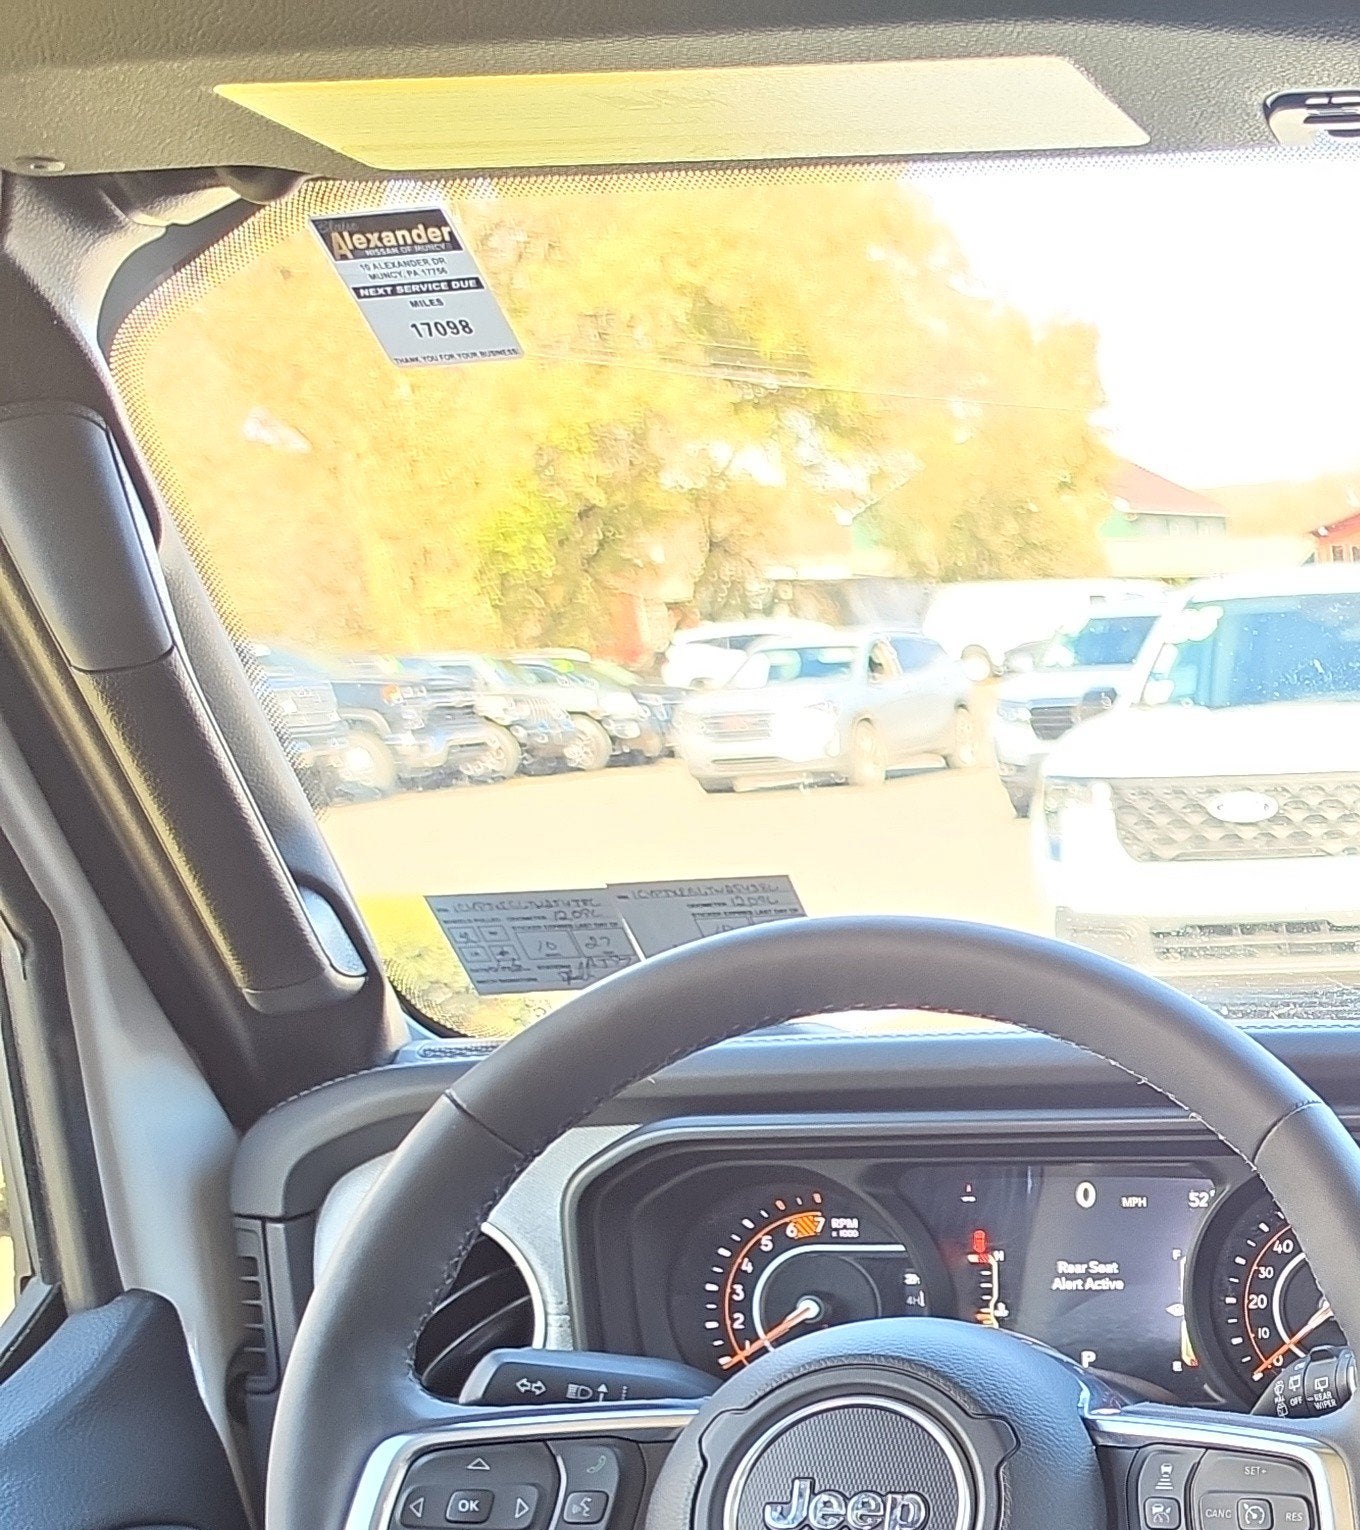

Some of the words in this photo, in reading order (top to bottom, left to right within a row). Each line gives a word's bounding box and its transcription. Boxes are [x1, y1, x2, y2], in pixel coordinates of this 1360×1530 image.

[330, 222, 452, 261] Alexander
[365, 247, 399, 257] NISSAN
[401, 246, 412, 254] OF
[414, 243, 446, 253] MUNCY
[373, 258, 429, 271] ALEXANDER
[432, 256, 447, 267] DR
[406, 269, 420, 278] PA
[360, 286, 394, 297] NEXT
[396, 282, 450, 294] SERVICE
[451, 279, 477, 290] DUE
[409, 298, 444, 309] MILES
[410, 318, 474, 339] 17098
[422, 355, 437, 363] YOU
[438, 353, 456, 362] FOR
[1075, 1181, 1096, 1208] 0
[1121, 1196, 1147, 1208] MPH
[815, 1216, 826, 1233] 7
[831, 1217, 859, 1229] RPM
[786, 1223, 798, 1238] 6
[760, 1235, 774, 1252] 5
[1272, 1239, 1294, 1254] 40
[741, 1258, 753, 1273] 4
[1056, 1260, 1087, 1274] Rear
[1088, 1260, 1119, 1274] Seat
[1258, 1266, 1274, 1279] 30
[1052, 1278, 1084, 1290] Alert
[1085, 1278, 1124, 1290] Active
[732, 1284, 745, 1301] 3
[1248, 1293, 1268, 1309] 20
[732, 1313, 745, 1330] 2
[1258, 1327, 1270, 1339] 10
[1080, 1350, 1096, 1368] P
[1290, 1396, 1302, 1407] OFF
[1314, 1391, 1332, 1401] REAR
[1314, 1400, 1337, 1411] WIPER
[458, 1499, 479, 1513] OK
[1205, 1508, 1232, 1520] CANC
[1285, 1511, 1303, 1523] RES
